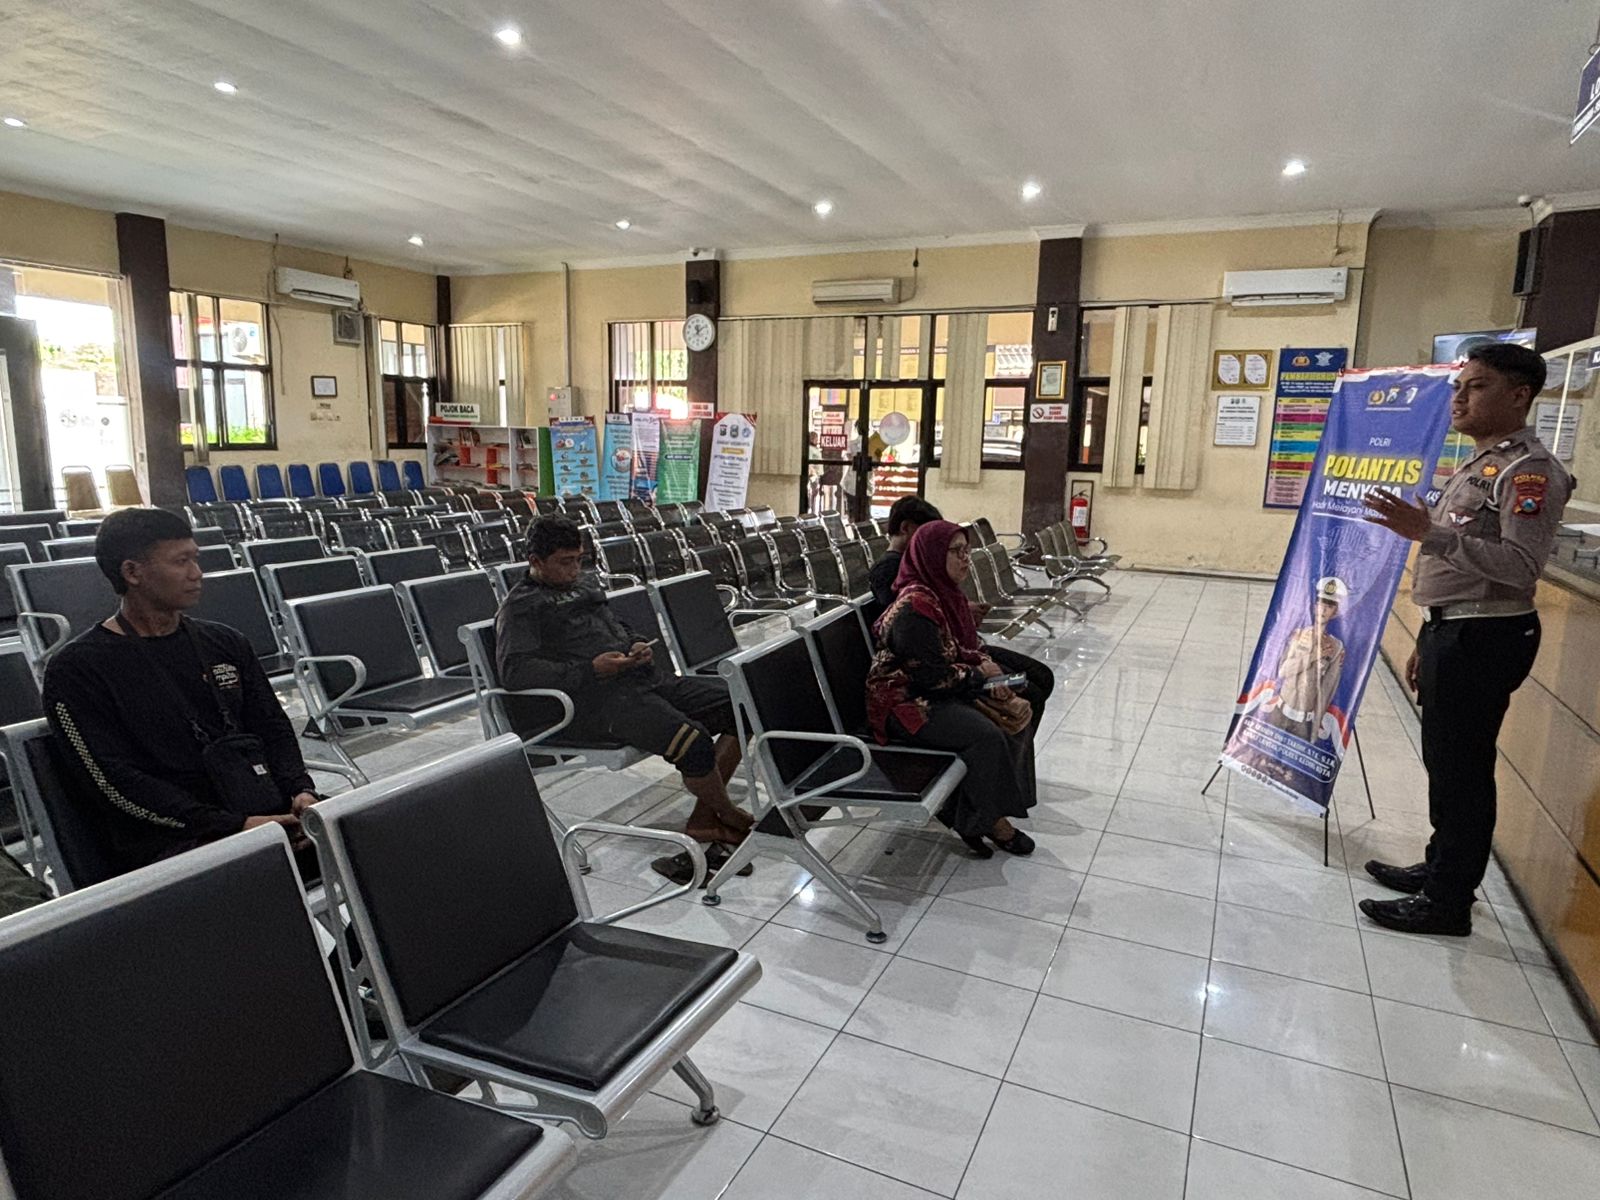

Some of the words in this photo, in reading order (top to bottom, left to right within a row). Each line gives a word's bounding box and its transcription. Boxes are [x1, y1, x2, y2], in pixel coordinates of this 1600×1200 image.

[440, 404, 459, 413] POJOK
[459, 405, 475, 414] BACA
[821, 435, 846, 448] KELUAR
[1369, 436, 1392, 447] POLRI
[1323, 454, 1423, 485] POLANTAS
[1467, 475, 1491, 491] POLRI
